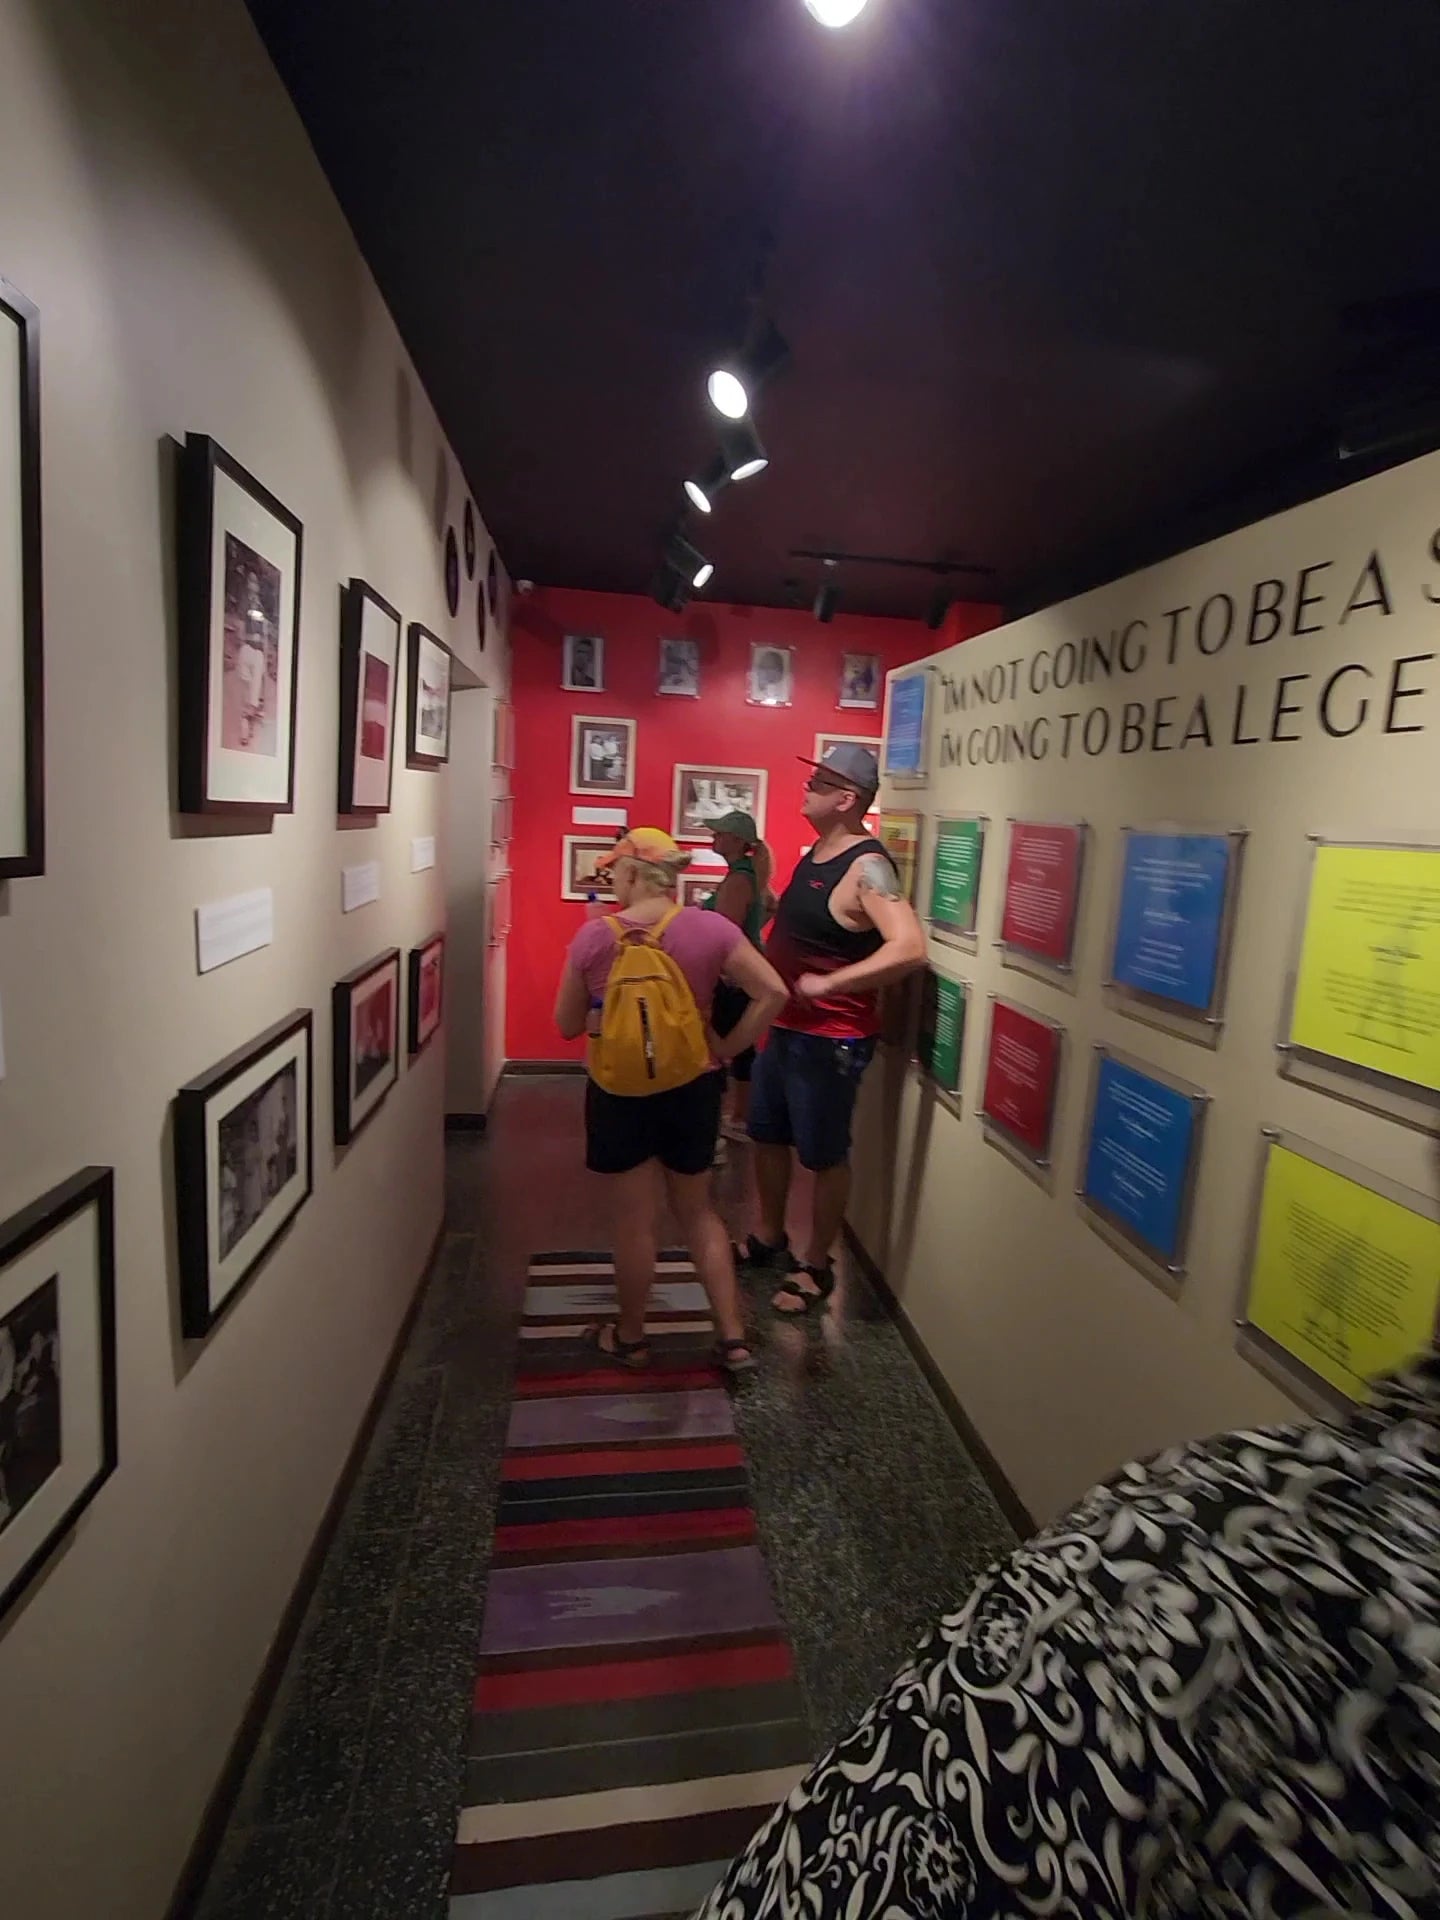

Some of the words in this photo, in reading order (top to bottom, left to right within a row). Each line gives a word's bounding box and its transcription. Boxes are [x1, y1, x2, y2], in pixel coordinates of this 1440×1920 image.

[971, 659, 1024, 709] NOT
[1030, 619, 1149, 695] GOING
[1162, 593, 1234, 666] TO
[1246, 560, 1336, 646] BE
[1338, 546, 1396, 626] A
[967, 717, 1051, 765] GOING
[1059, 706, 1110, 759] TO
[1119, 695, 1180, 754] BE
[1180, 692, 1213, 750] A
